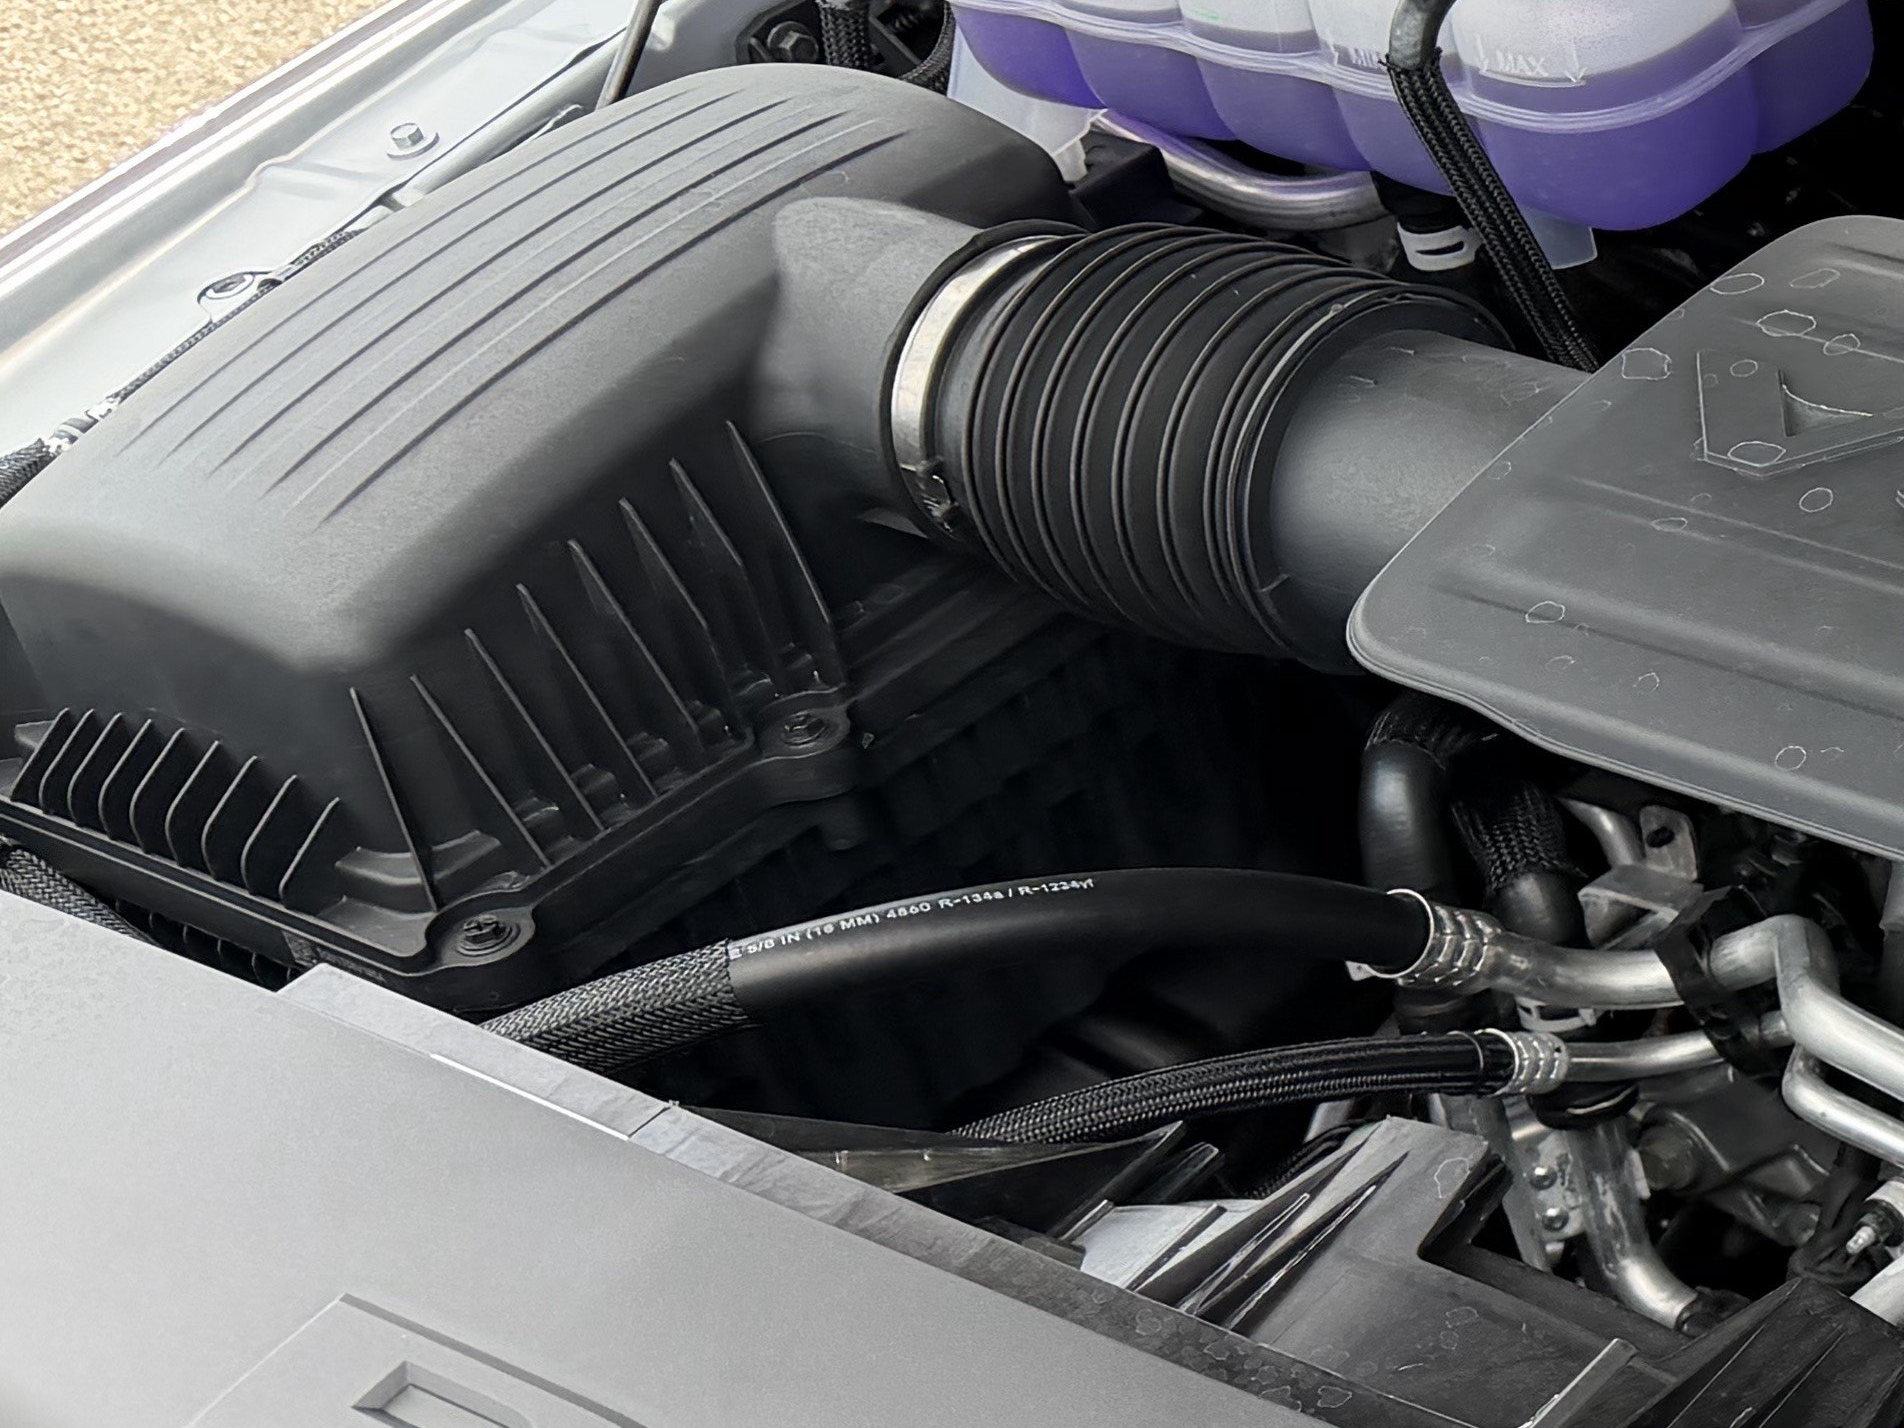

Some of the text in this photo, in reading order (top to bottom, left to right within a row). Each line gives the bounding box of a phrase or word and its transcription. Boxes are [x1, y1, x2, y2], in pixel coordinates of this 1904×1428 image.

[1495, 50, 1548, 77] MAX
[781, 932, 800, 945] IN
[840, 913, 880, 931] MM)
